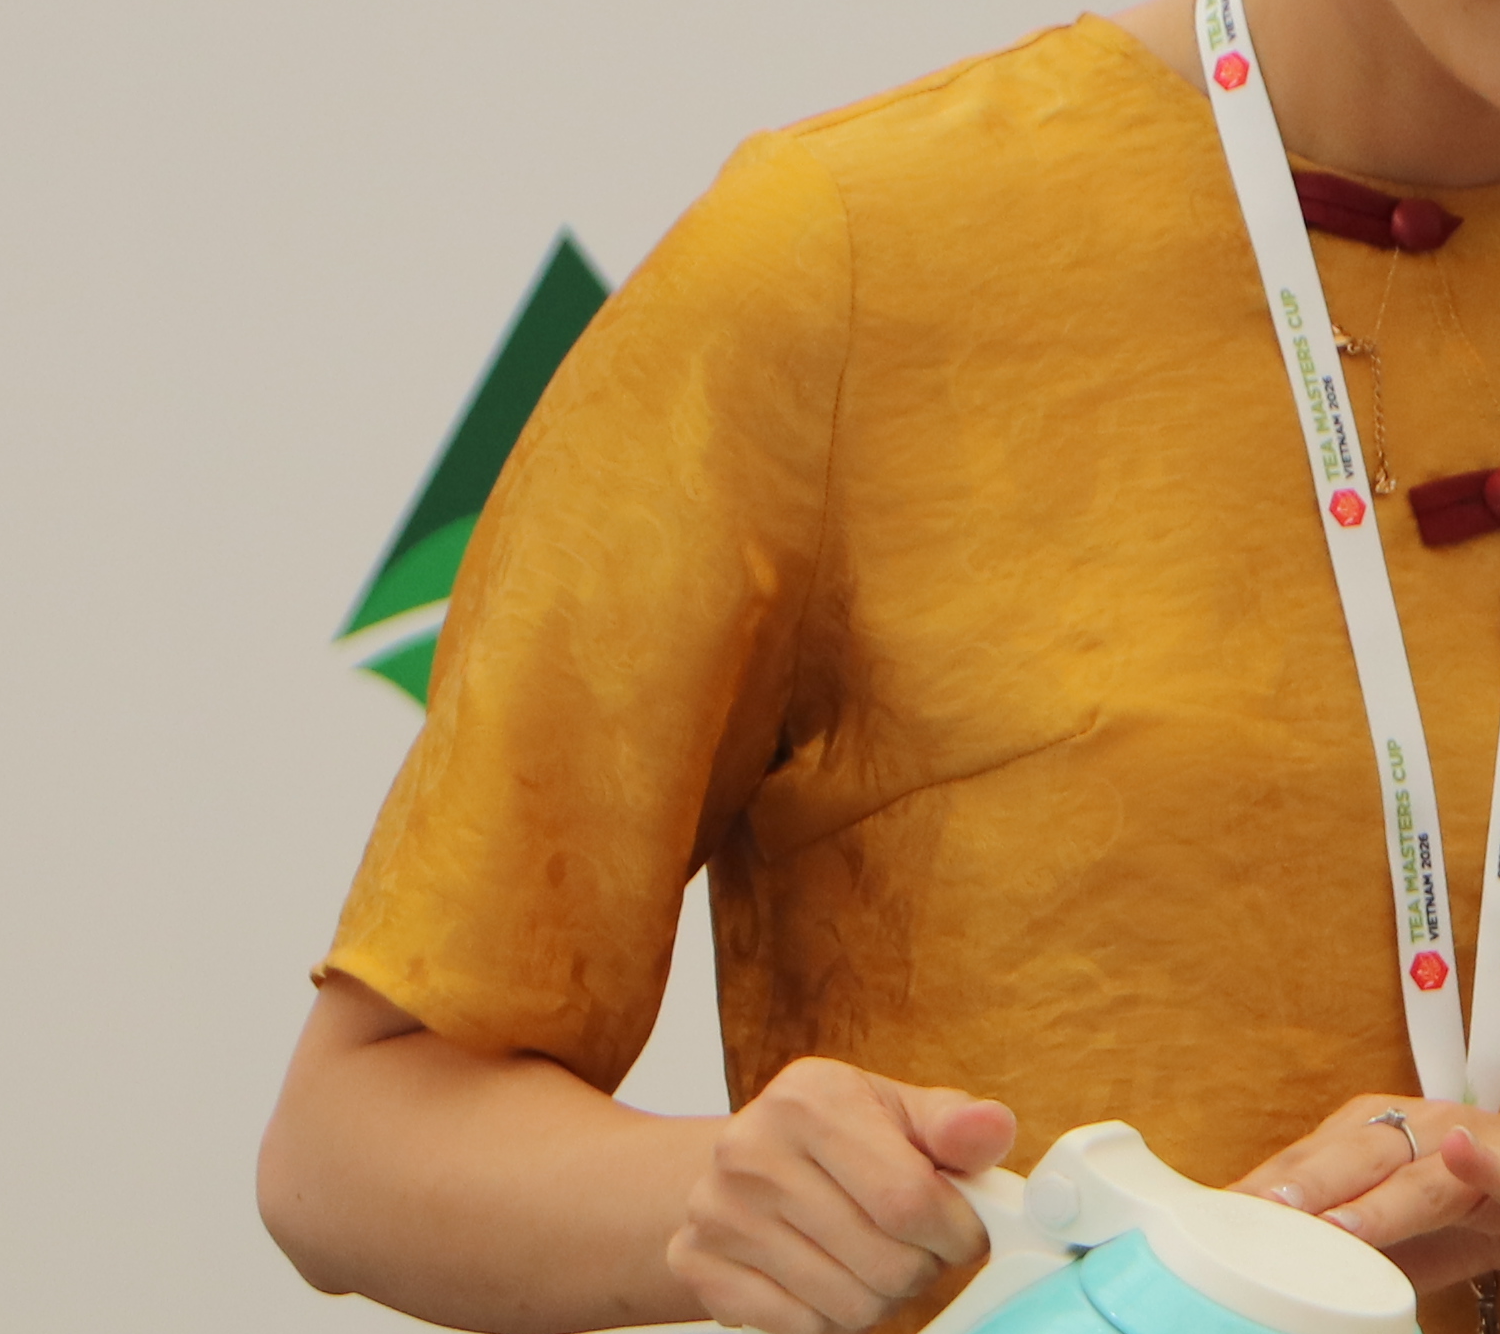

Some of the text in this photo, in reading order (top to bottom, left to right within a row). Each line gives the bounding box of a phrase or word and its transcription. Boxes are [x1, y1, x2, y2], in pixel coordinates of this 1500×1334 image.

[1280, 287, 1341, 482] TEA MASTERS CUP
[1322, 375, 1354, 479] VIETNAM 2026
[1387, 738, 1425, 944] TEA MASTERS CUP
[1418, 832, 1440, 942] VIETNAM 2026
